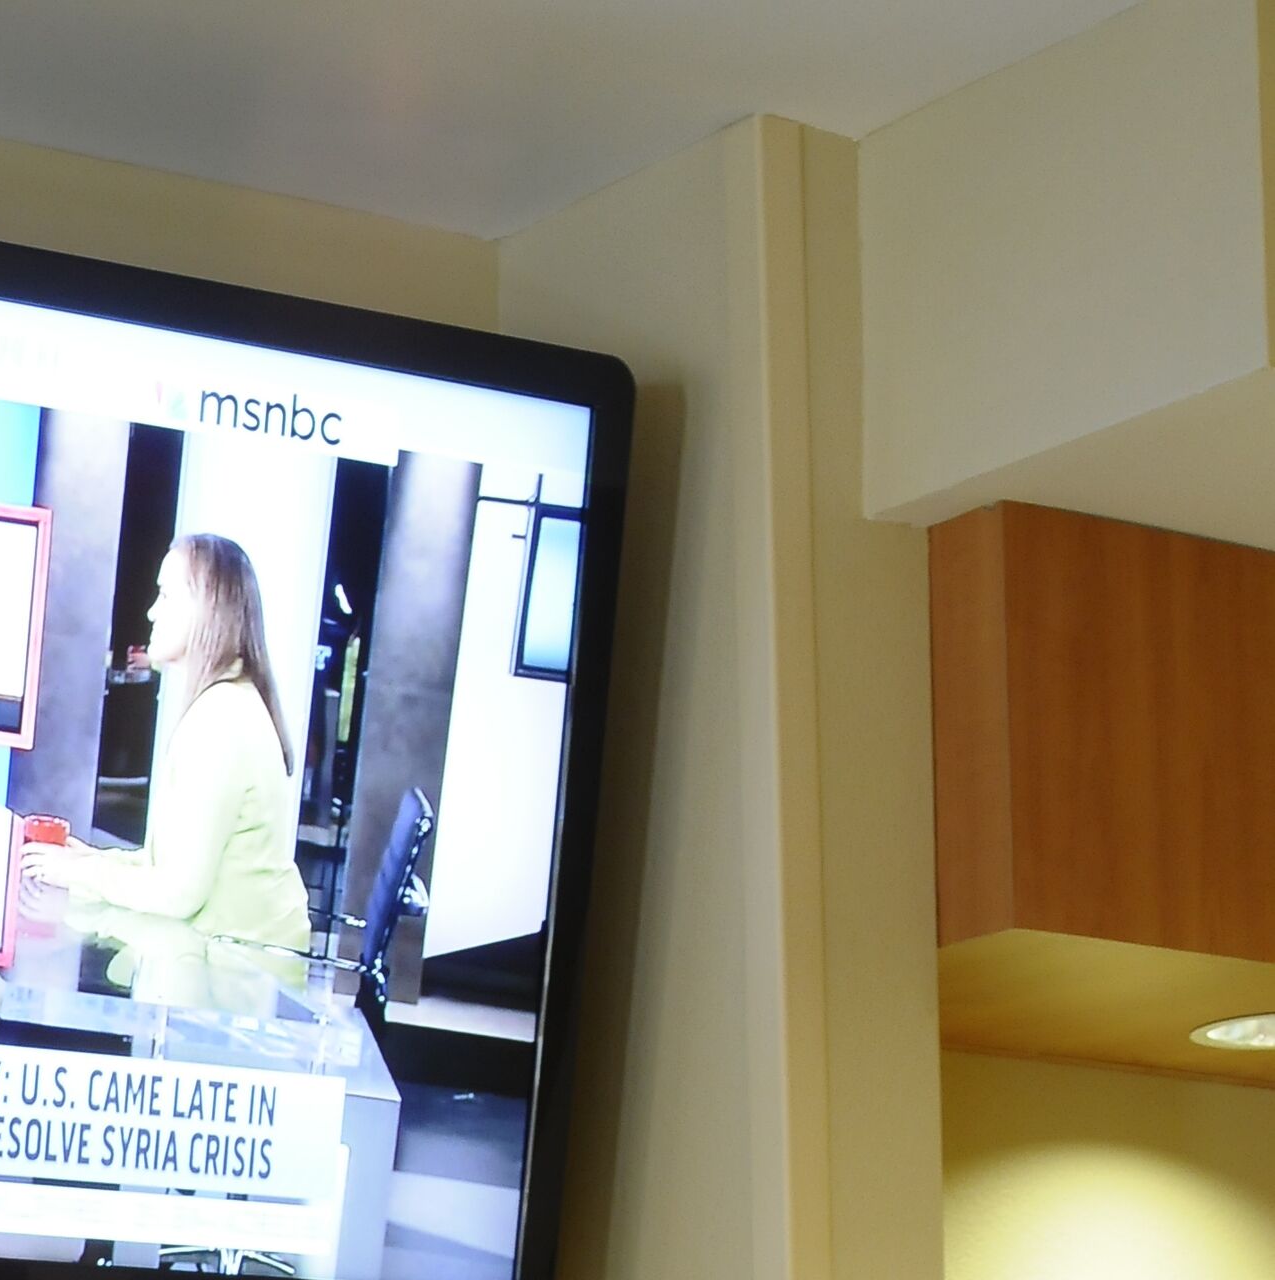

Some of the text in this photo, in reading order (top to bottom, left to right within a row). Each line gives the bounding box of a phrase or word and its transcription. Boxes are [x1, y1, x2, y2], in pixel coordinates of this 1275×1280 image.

[199, 388, 343, 446] msnbc
[20, 1061, 75, 1110] U.S.
[87, 1069, 162, 1117] CAME
[171, 1075, 238, 1124] LATE
[248, 1084, 276, 1127] IN
[101, 1124, 179, 1172] SYRIA
[188, 1132, 273, 1180] CRISIS
